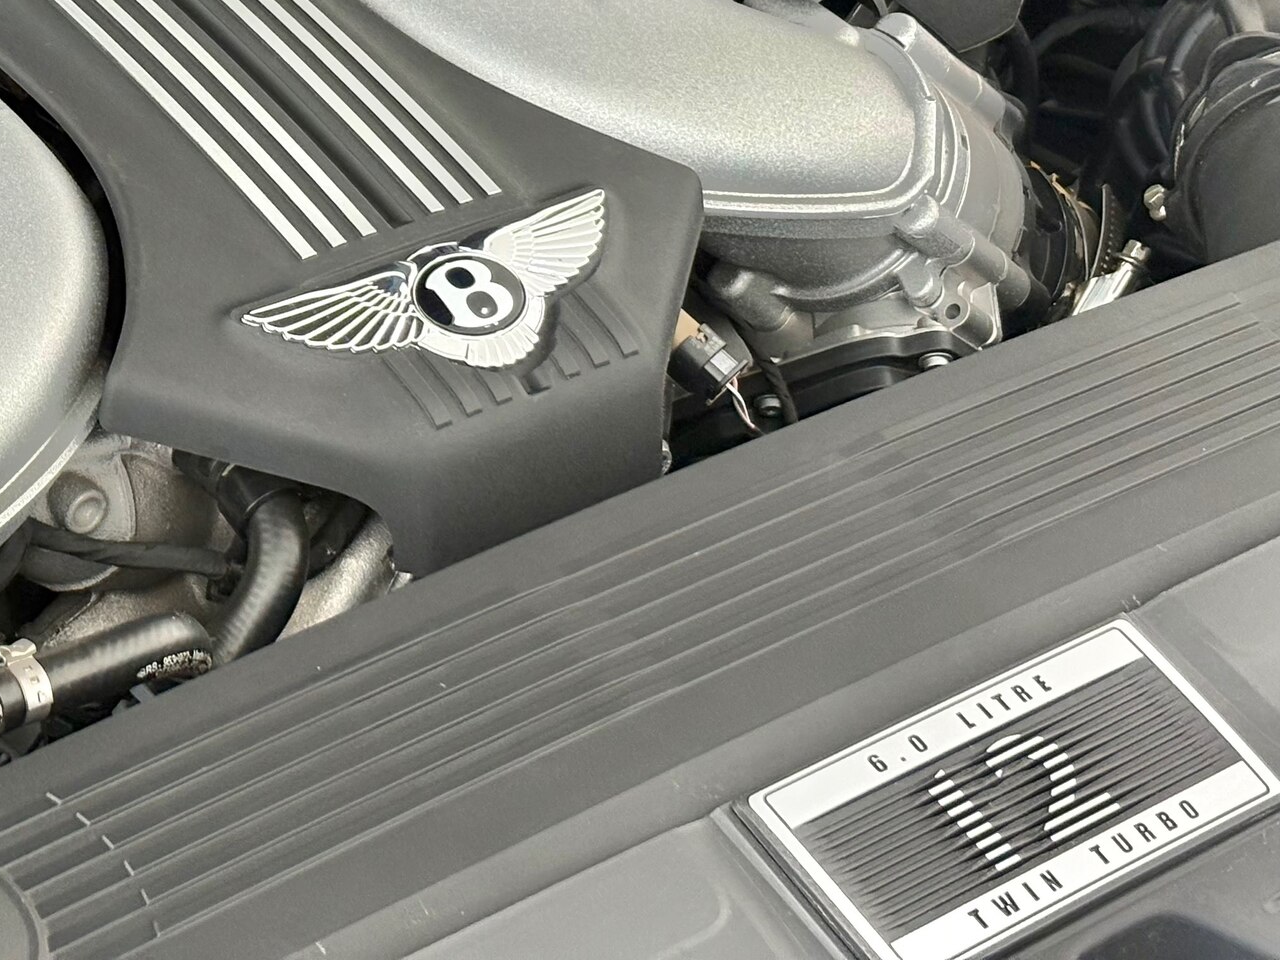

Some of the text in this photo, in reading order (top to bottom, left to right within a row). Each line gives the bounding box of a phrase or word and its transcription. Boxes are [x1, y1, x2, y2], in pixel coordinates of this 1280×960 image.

[425, 259, 514, 328] B
[867, 673, 1053, 773] 6.0 LITRE
[928, 734, 1120, 870] 12
[967, 799, 1200, 930] TWIN TURBO
